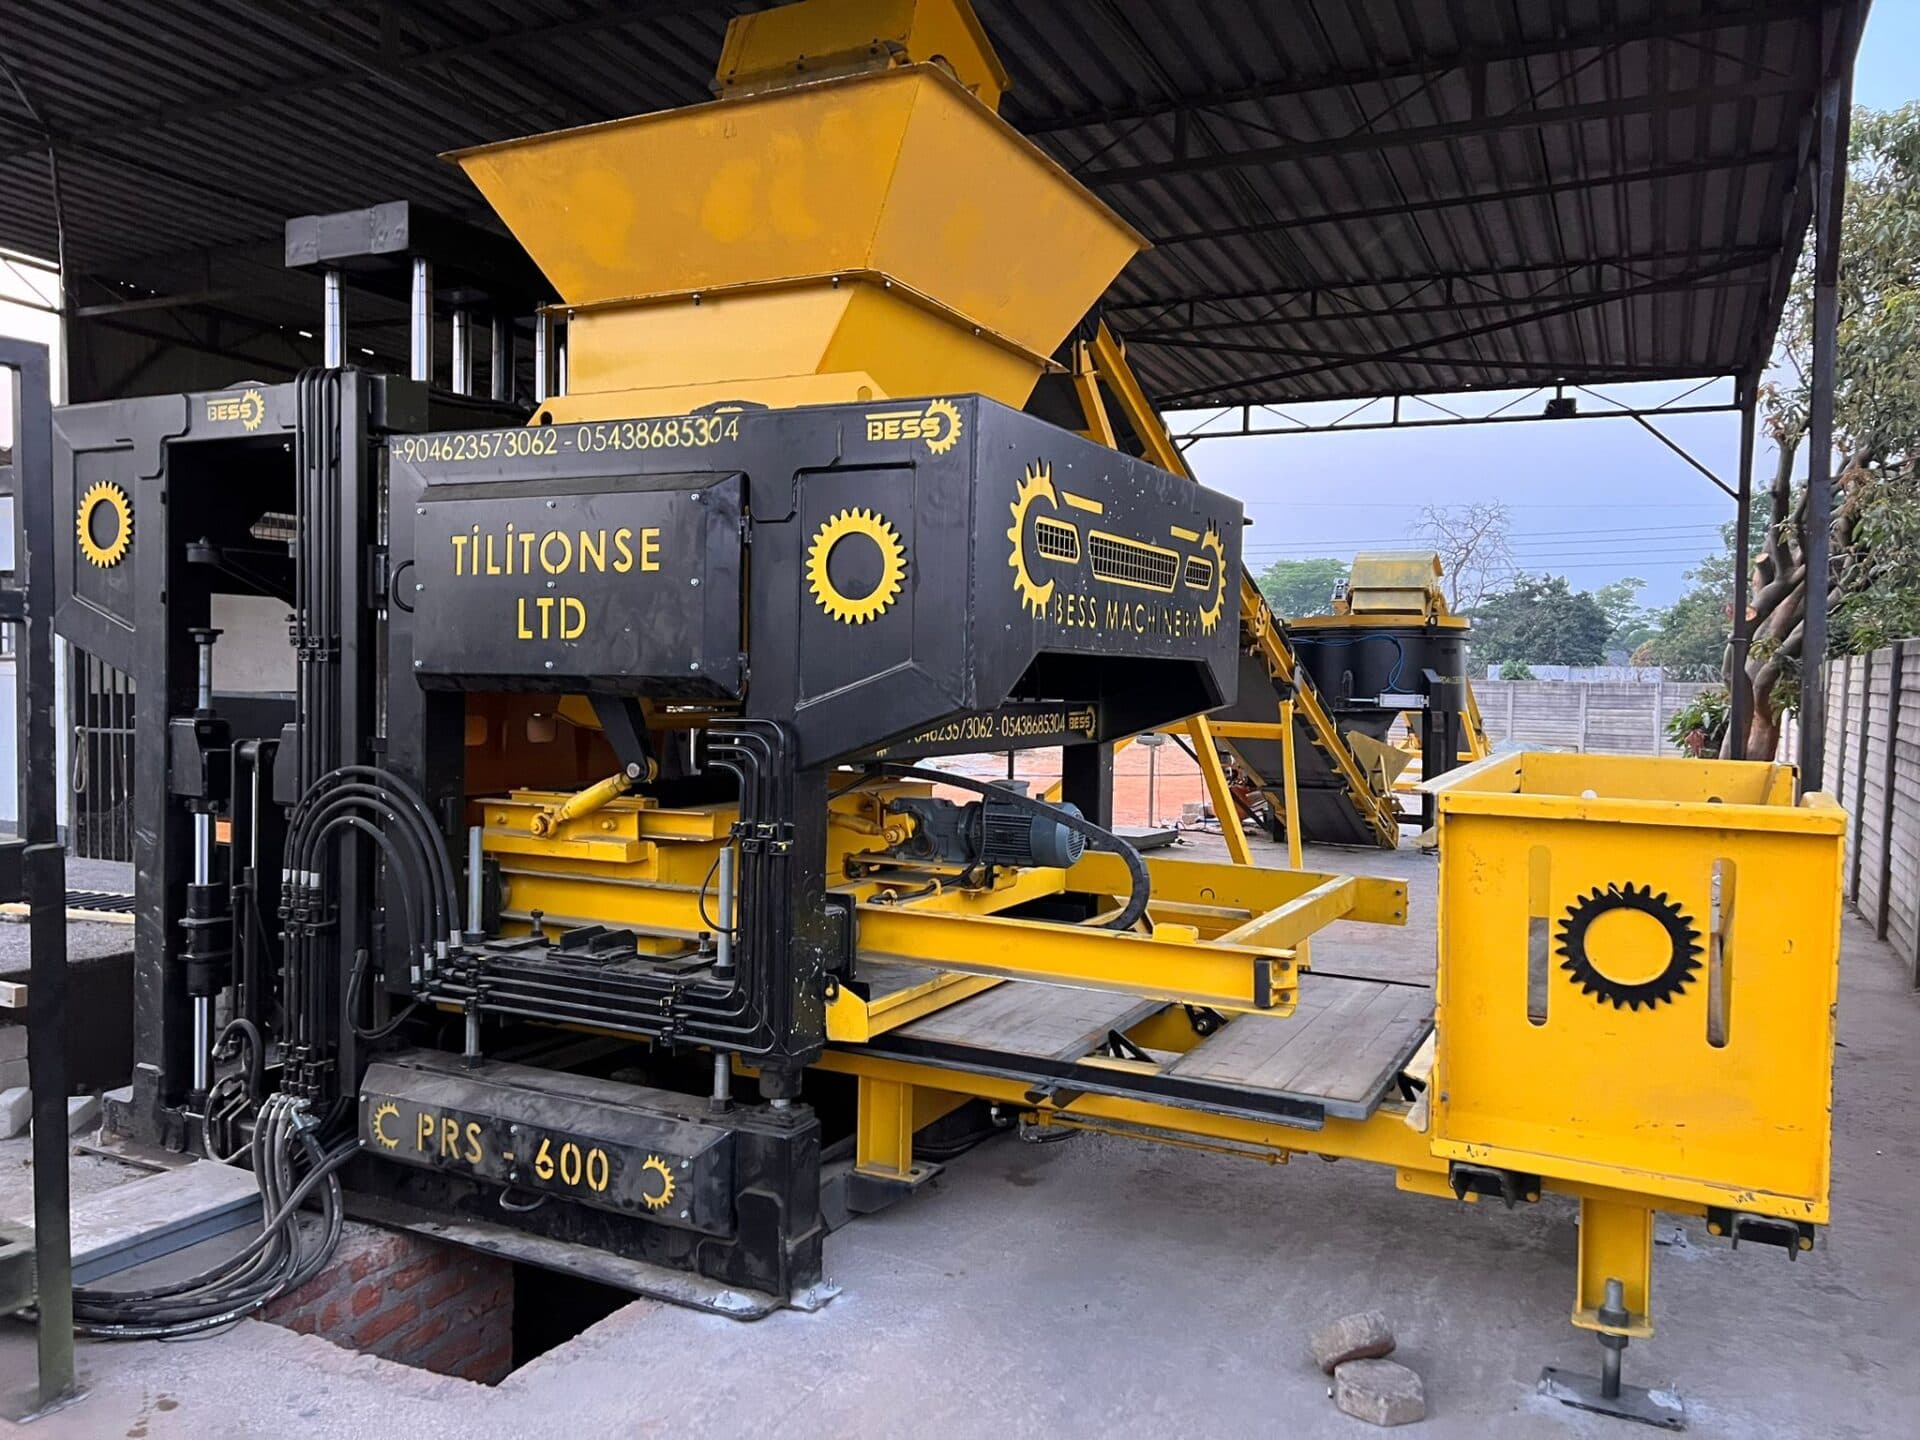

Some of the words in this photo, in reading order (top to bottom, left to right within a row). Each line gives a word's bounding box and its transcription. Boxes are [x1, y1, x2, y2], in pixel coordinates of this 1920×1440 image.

[207, 403, 252, 421] BESS
[866, 417, 940, 441] BESS
[392, 428, 558, 464] +904623573062
[577, 415, 740, 453] 05438685304
[517, 597, 587, 640] LTD
[1054, 592, 1097, 629] BESS
[1105, 599, 1199, 638] MACHINERY
[1001, 712, 1066, 738] 05438685304
[1067, 715, 1091, 731] BESS
[416, 1111, 484, 1165] PRS
[534, 1137, 610, 1193] 600
